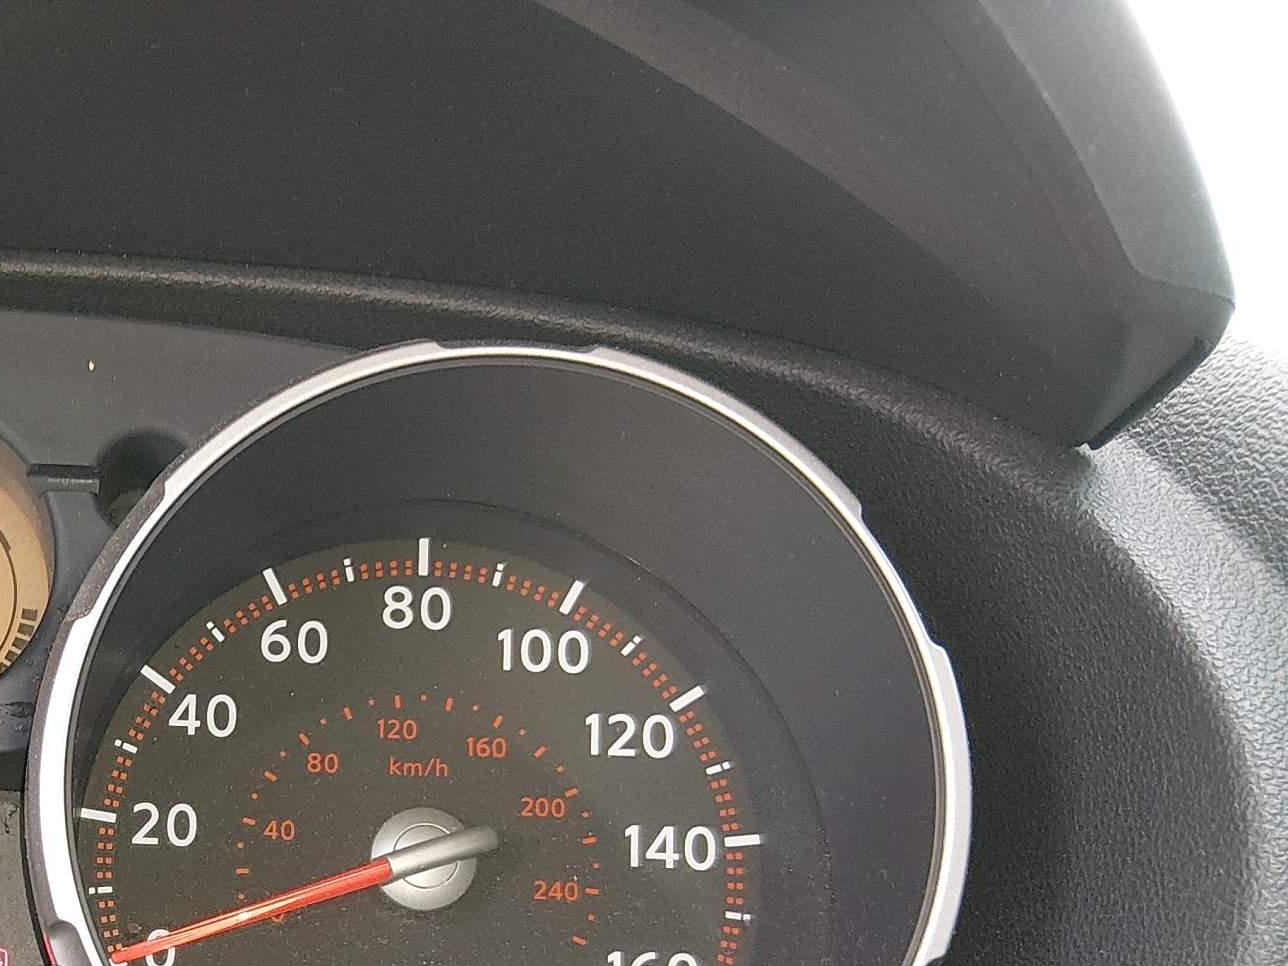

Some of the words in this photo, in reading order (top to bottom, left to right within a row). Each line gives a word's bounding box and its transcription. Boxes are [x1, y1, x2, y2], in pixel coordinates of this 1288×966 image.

[383, 586, 450, 630] 80
[262, 620, 327, 663] 60
[498, 629, 589, 673] 100
[168, 694, 237, 738] 40
[379, 720, 417, 740] 120
[467, 737, 507, 758] 160
[585, 713, 674, 758] 120
[308, 753, 339, 773] 80
[388, 756, 448, 778] km/h
[521, 798, 566, 817] 200
[132, 803, 196, 846] 20
[264, 820, 296, 840] 40
[625, 825, 716, 870] 140
[536, 880, 579, 901] 240
